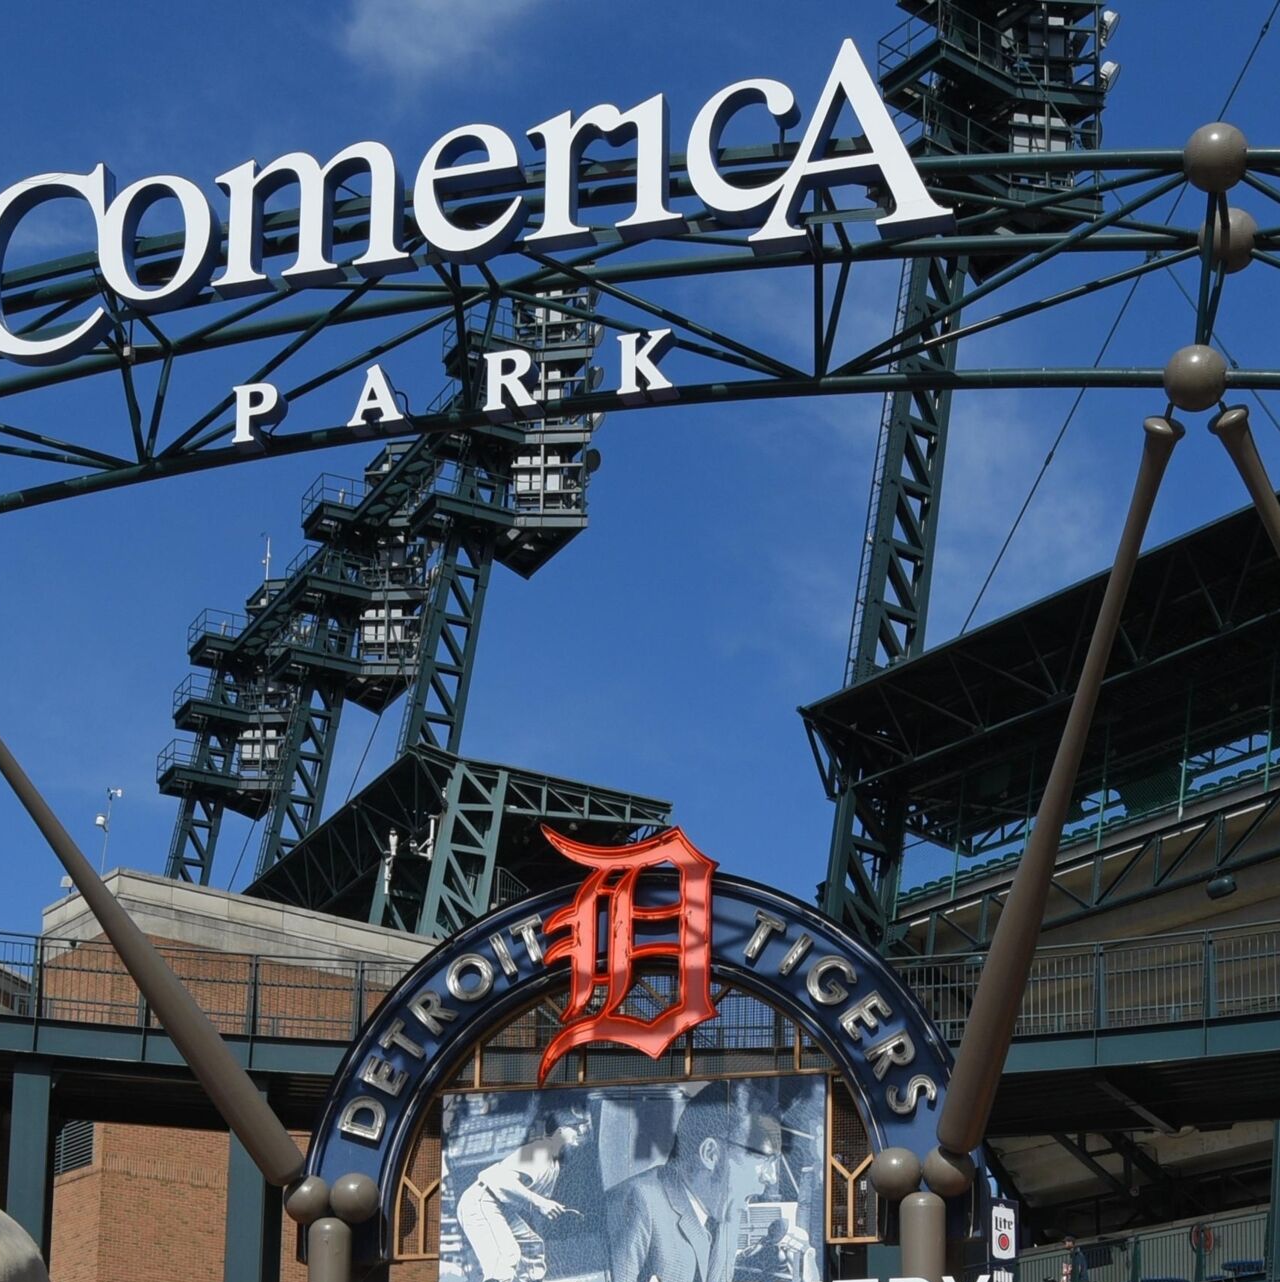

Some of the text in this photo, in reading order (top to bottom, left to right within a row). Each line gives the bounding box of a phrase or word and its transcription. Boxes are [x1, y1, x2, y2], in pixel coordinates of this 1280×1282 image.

[231, 328, 674, 445] PARK
[337, 909, 937, 1143] DETROIT TIGERS
[538, 823, 719, 1088] D
[994, 1215, 1014, 1232] Lite
